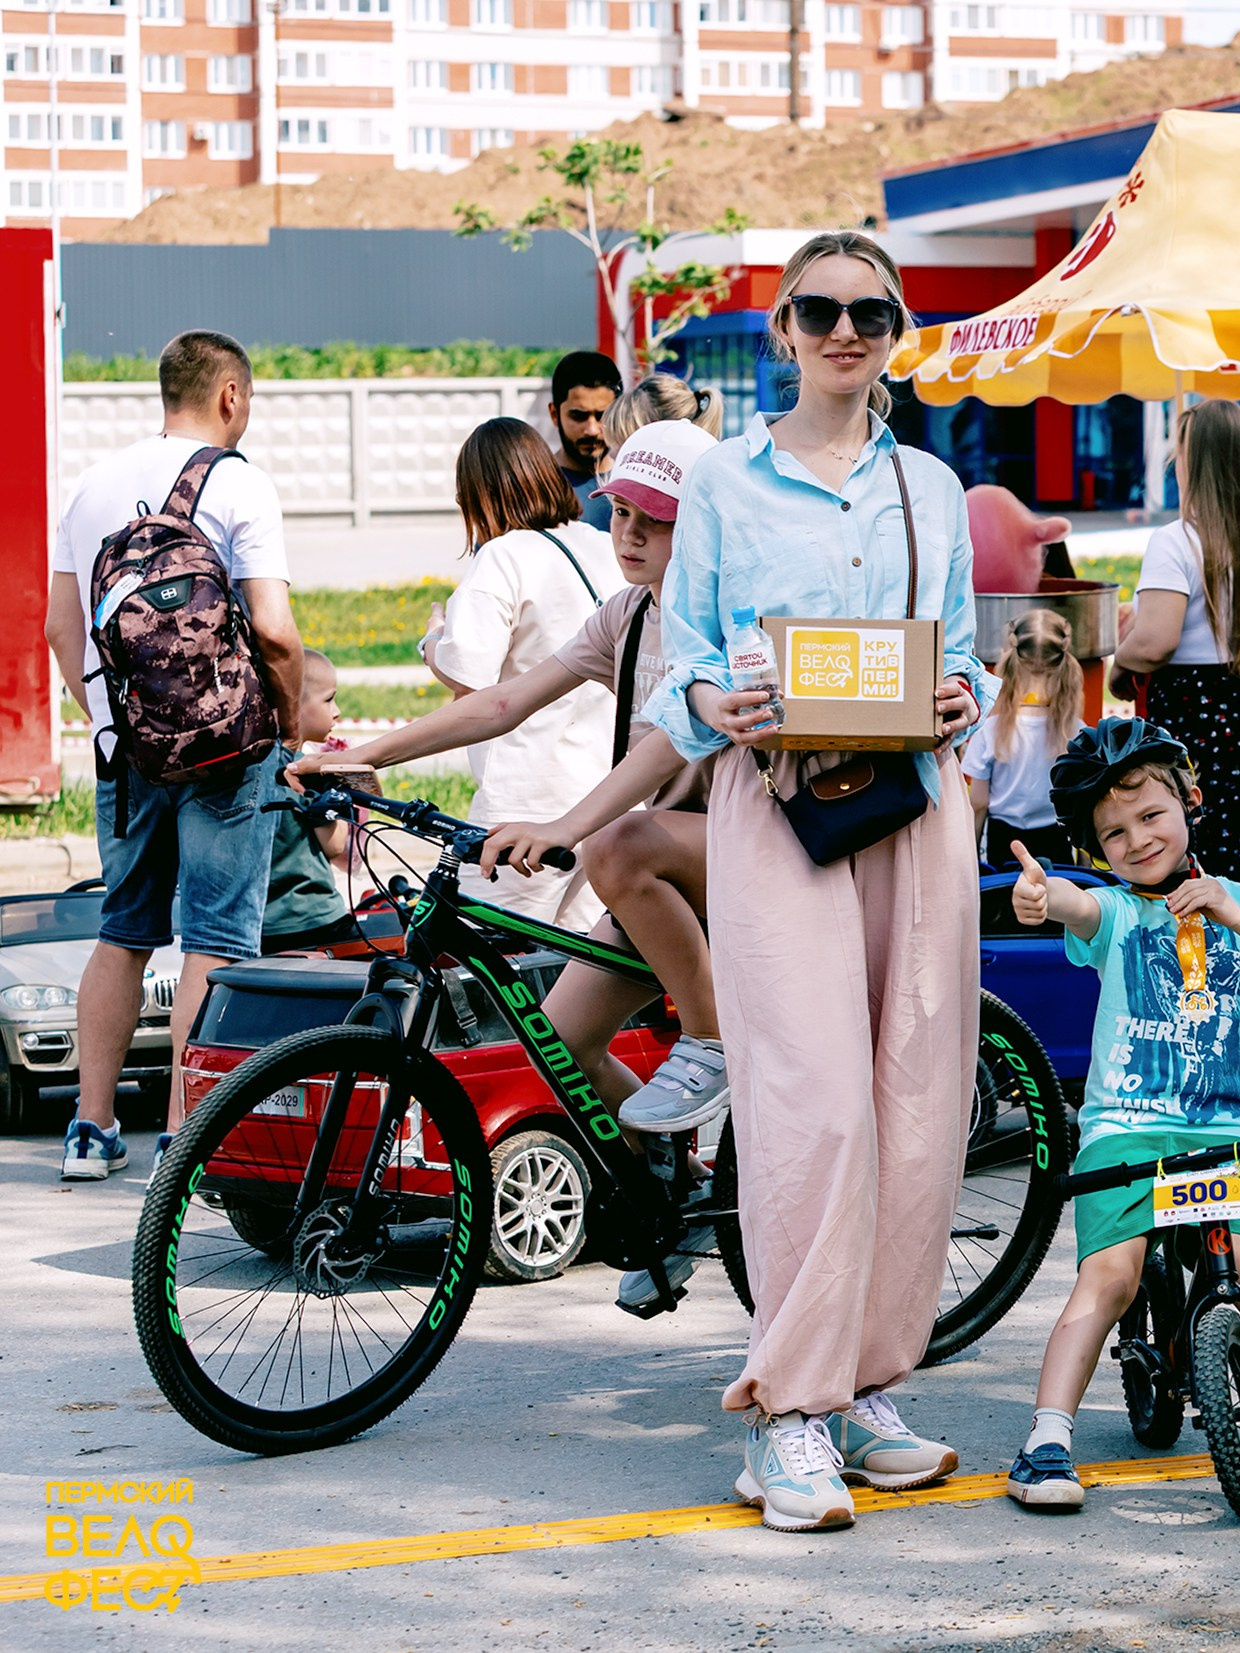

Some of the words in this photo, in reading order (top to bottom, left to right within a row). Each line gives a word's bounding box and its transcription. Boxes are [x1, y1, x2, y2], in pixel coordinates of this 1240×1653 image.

[950, 317, 1037, 356] ФИЛЕВСКОЕ
[620, 451, 683, 484] DREAMER
[734, 651, 763, 661] СВЯТОЙ
[800, 642, 851, 651] ПЕРМСКИЙ
[864, 641, 897, 652] КРУ
[732, 658, 768, 669] ИСТОЧНИК
[864, 684, 896, 696] МИ!
[1115, 1016, 1194, 1043] THERE
[1108, 1043, 1134, 1065] IS
[1103, 1071, 1143, 1092] NO
[1103, 1096, 1182, 1115] FINISH
[1172, 1179, 1228, 1206] 500
